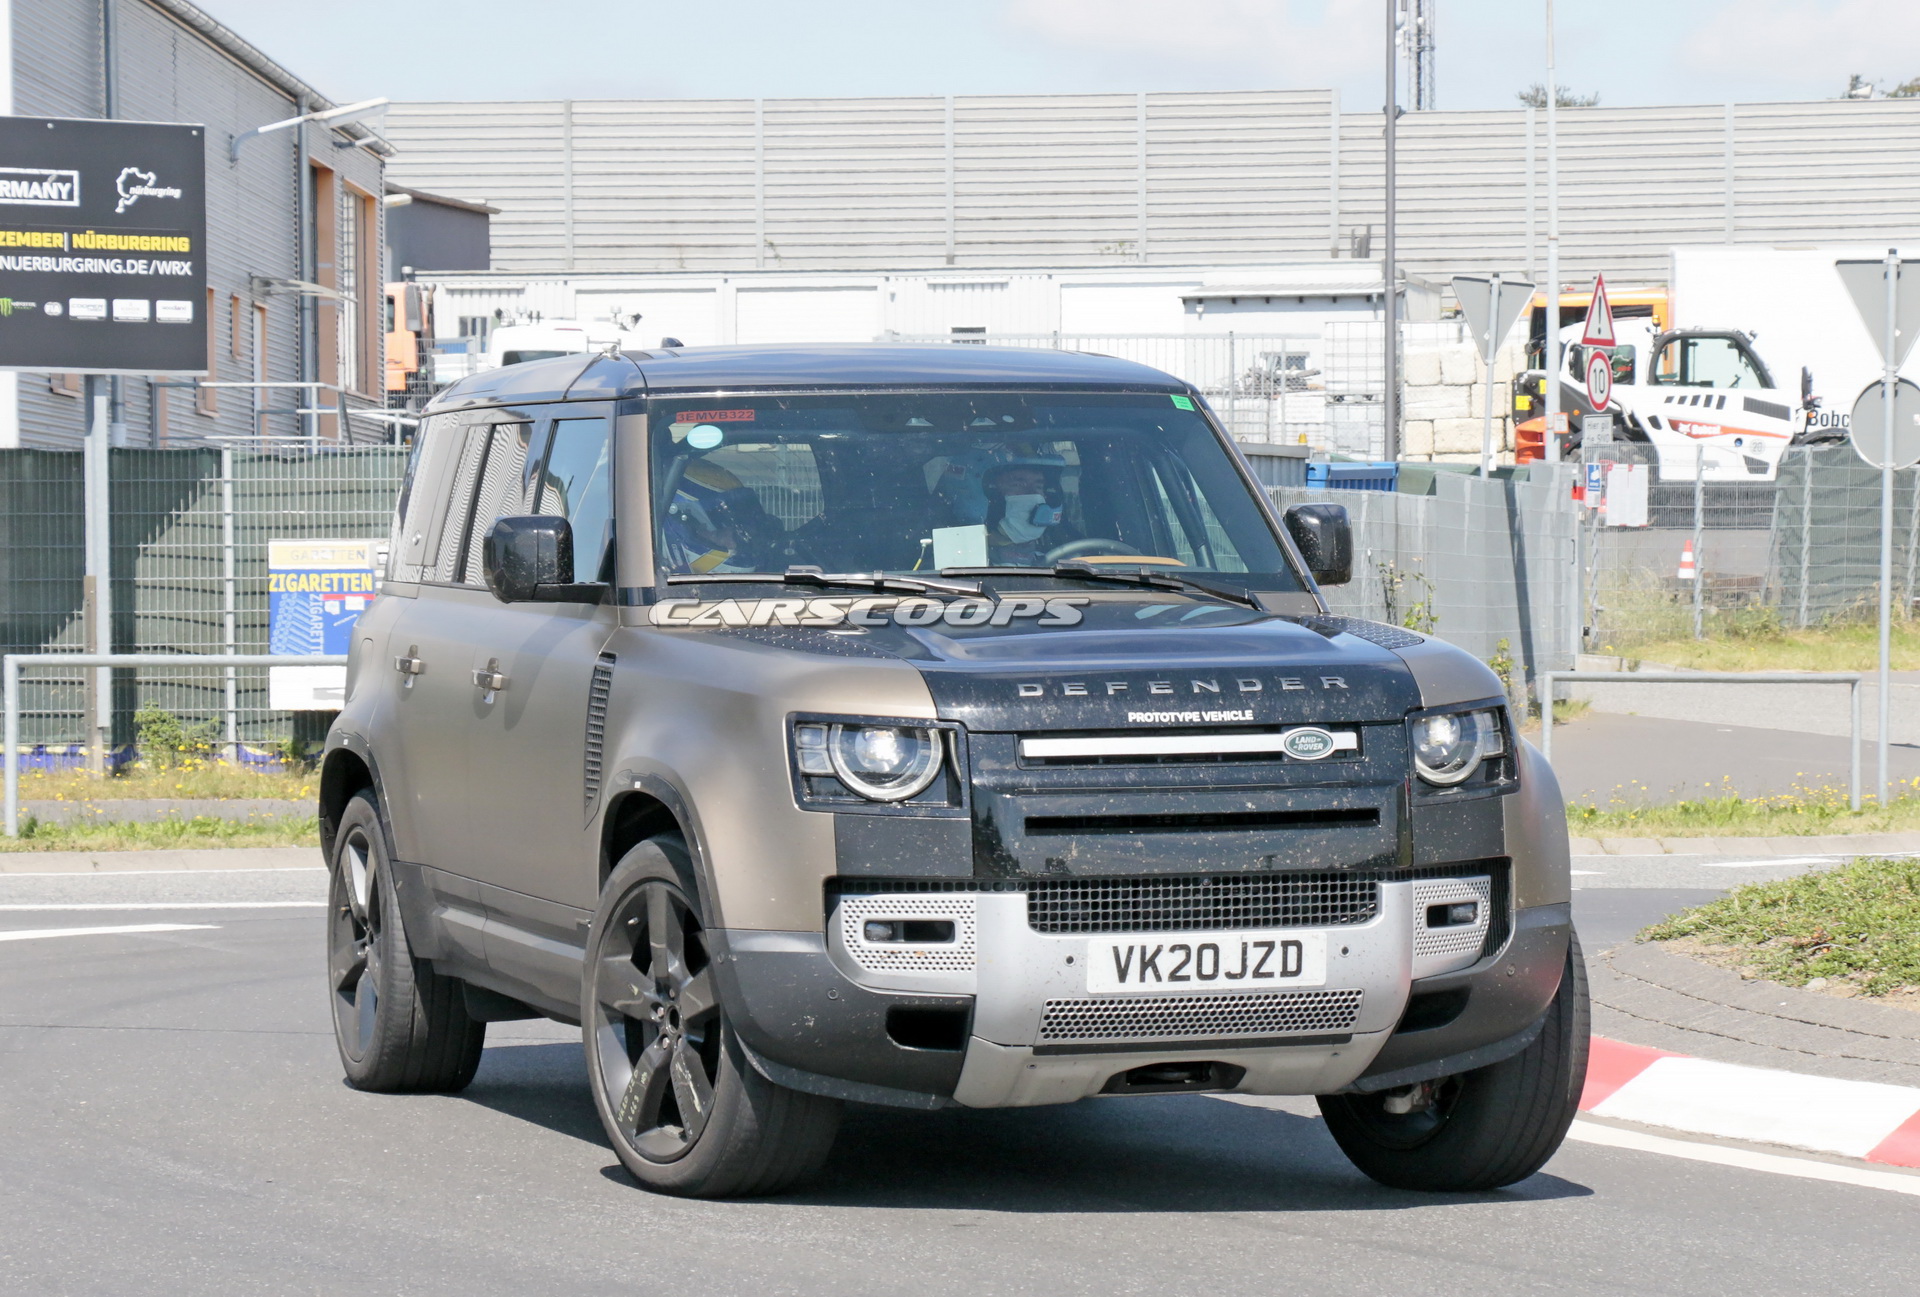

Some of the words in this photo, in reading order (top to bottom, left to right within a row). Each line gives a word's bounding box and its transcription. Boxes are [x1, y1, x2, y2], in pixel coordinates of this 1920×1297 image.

[0, 180, 73, 200] RMANY
[129, 185, 182, 199] nürburgring
[72, 229, 191, 252] NÜRBURGRING
[1593, 367, 1606, 394] 10
[678, 411, 754, 421] 3EMVB322
[1751, 441, 1763, 453] 20
[269, 573, 373, 592] ZIGARETTEN
[1017, 676, 1349, 697] DEFENDER
[1127, 711, 1201, 723] PROTOTYPE
[1202, 709, 1254, 722] VEHICLE
[1295, 736, 1317, 744] LAND
[1297, 742, 1324, 751] ROVER
